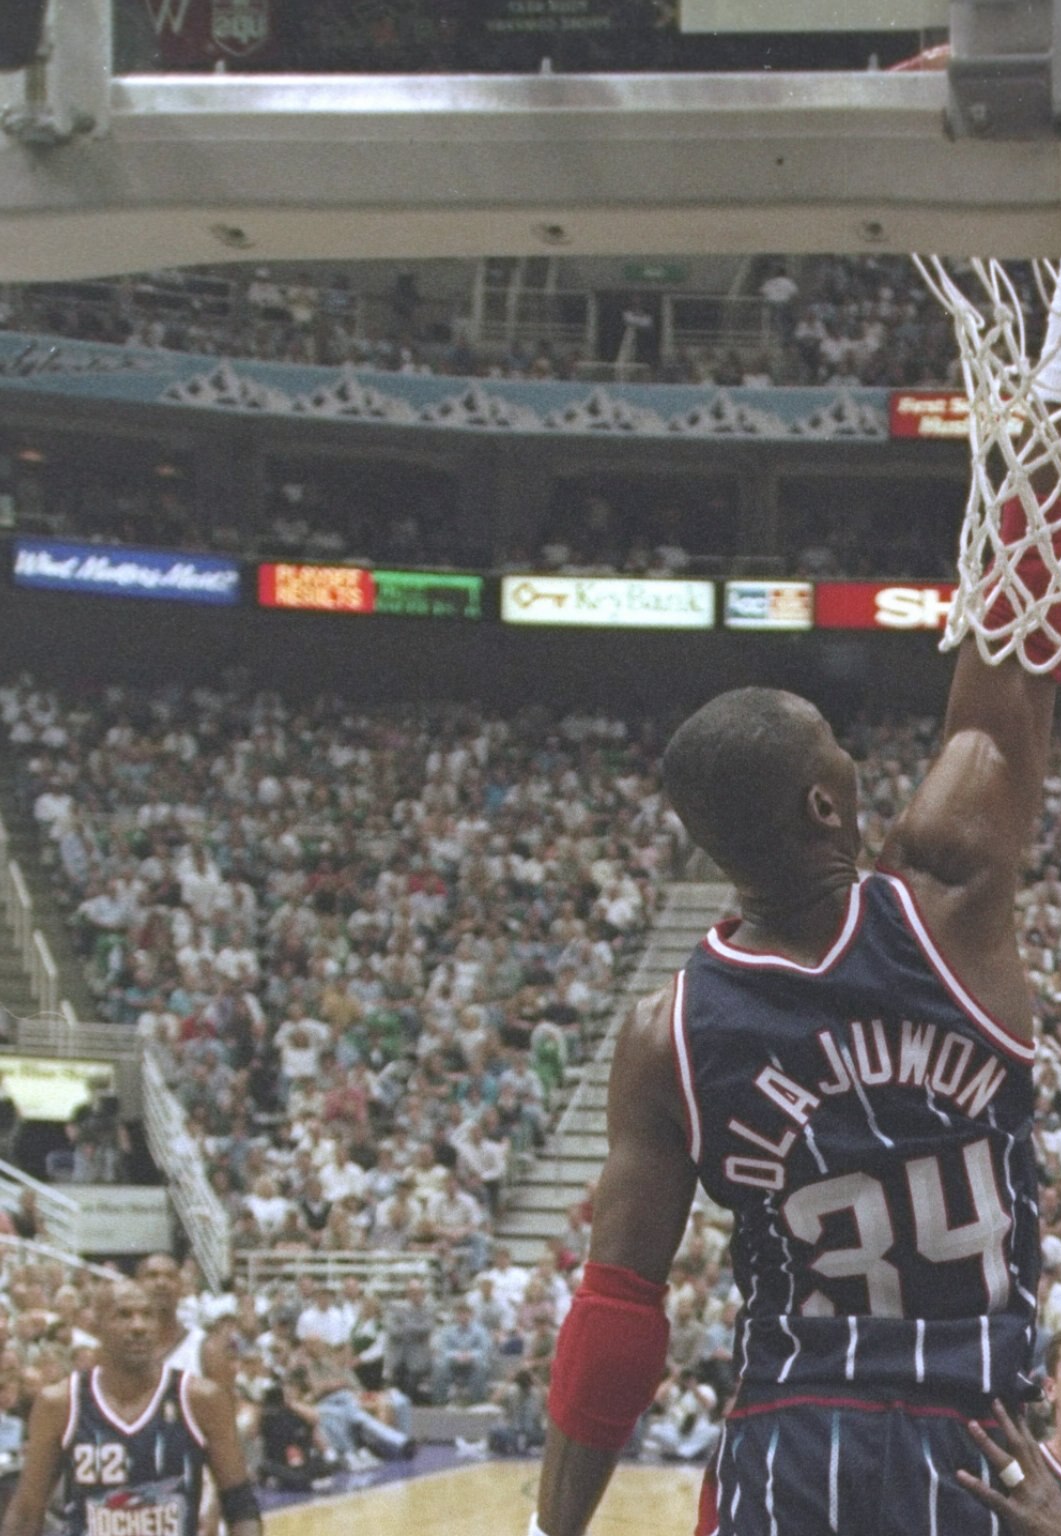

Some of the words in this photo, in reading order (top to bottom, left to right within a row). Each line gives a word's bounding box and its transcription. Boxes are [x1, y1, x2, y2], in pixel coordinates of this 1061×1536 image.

[725, 1019, 1007, 1191] OLAJUWON
[783, 1137, 1012, 1319] 34
[73, 1443, 128, 1484] 22
